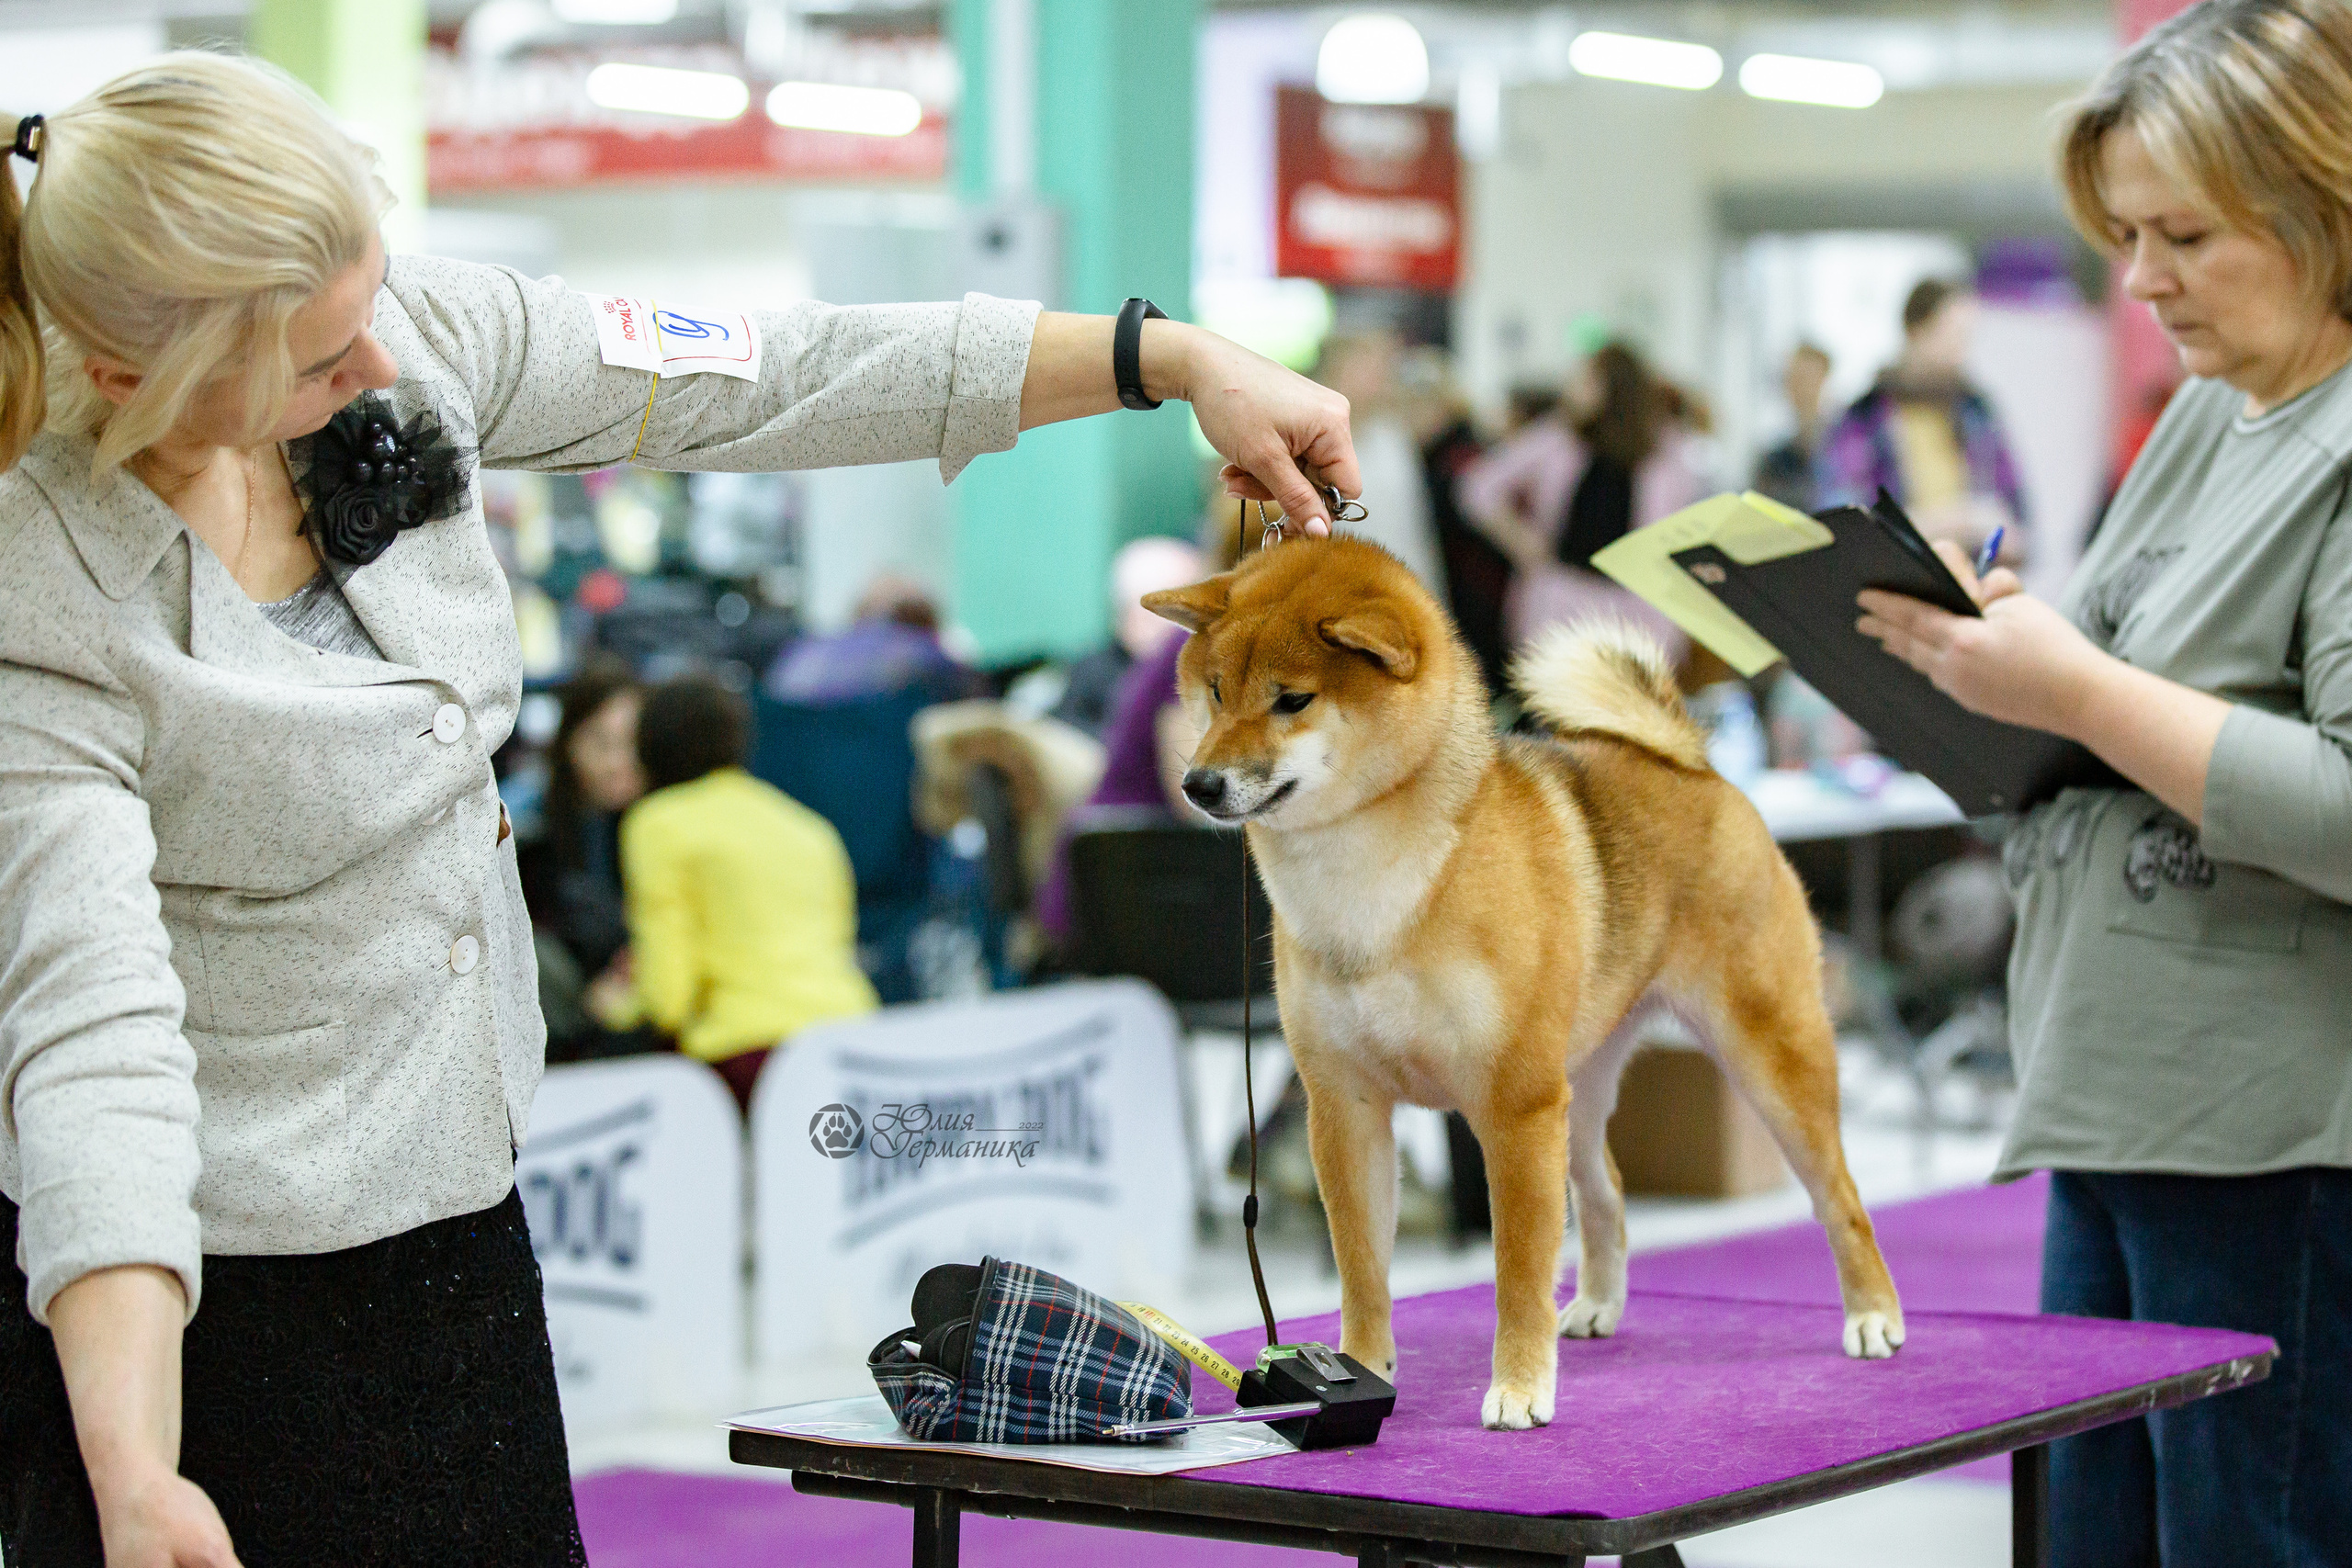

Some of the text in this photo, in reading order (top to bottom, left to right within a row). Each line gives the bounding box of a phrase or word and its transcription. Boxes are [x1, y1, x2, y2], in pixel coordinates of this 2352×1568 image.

[618, 308, 637, 342] ROYAL
[1153, 1317, 1163, 1325] 21
[1161, 1324, 1172, 1333] 22
[1170, 1331, 1182, 1340] 23
[1181, 1338, 1190, 1348] 24
[1190, 1346, 1200, 1356] 25
[1200, 1353, 1210, 1363] 26
[1211, 1360, 1220, 1371] 27
[1221, 1368, 1230, 1379] 28
[1231, 1376, 1240, 1387] 29
